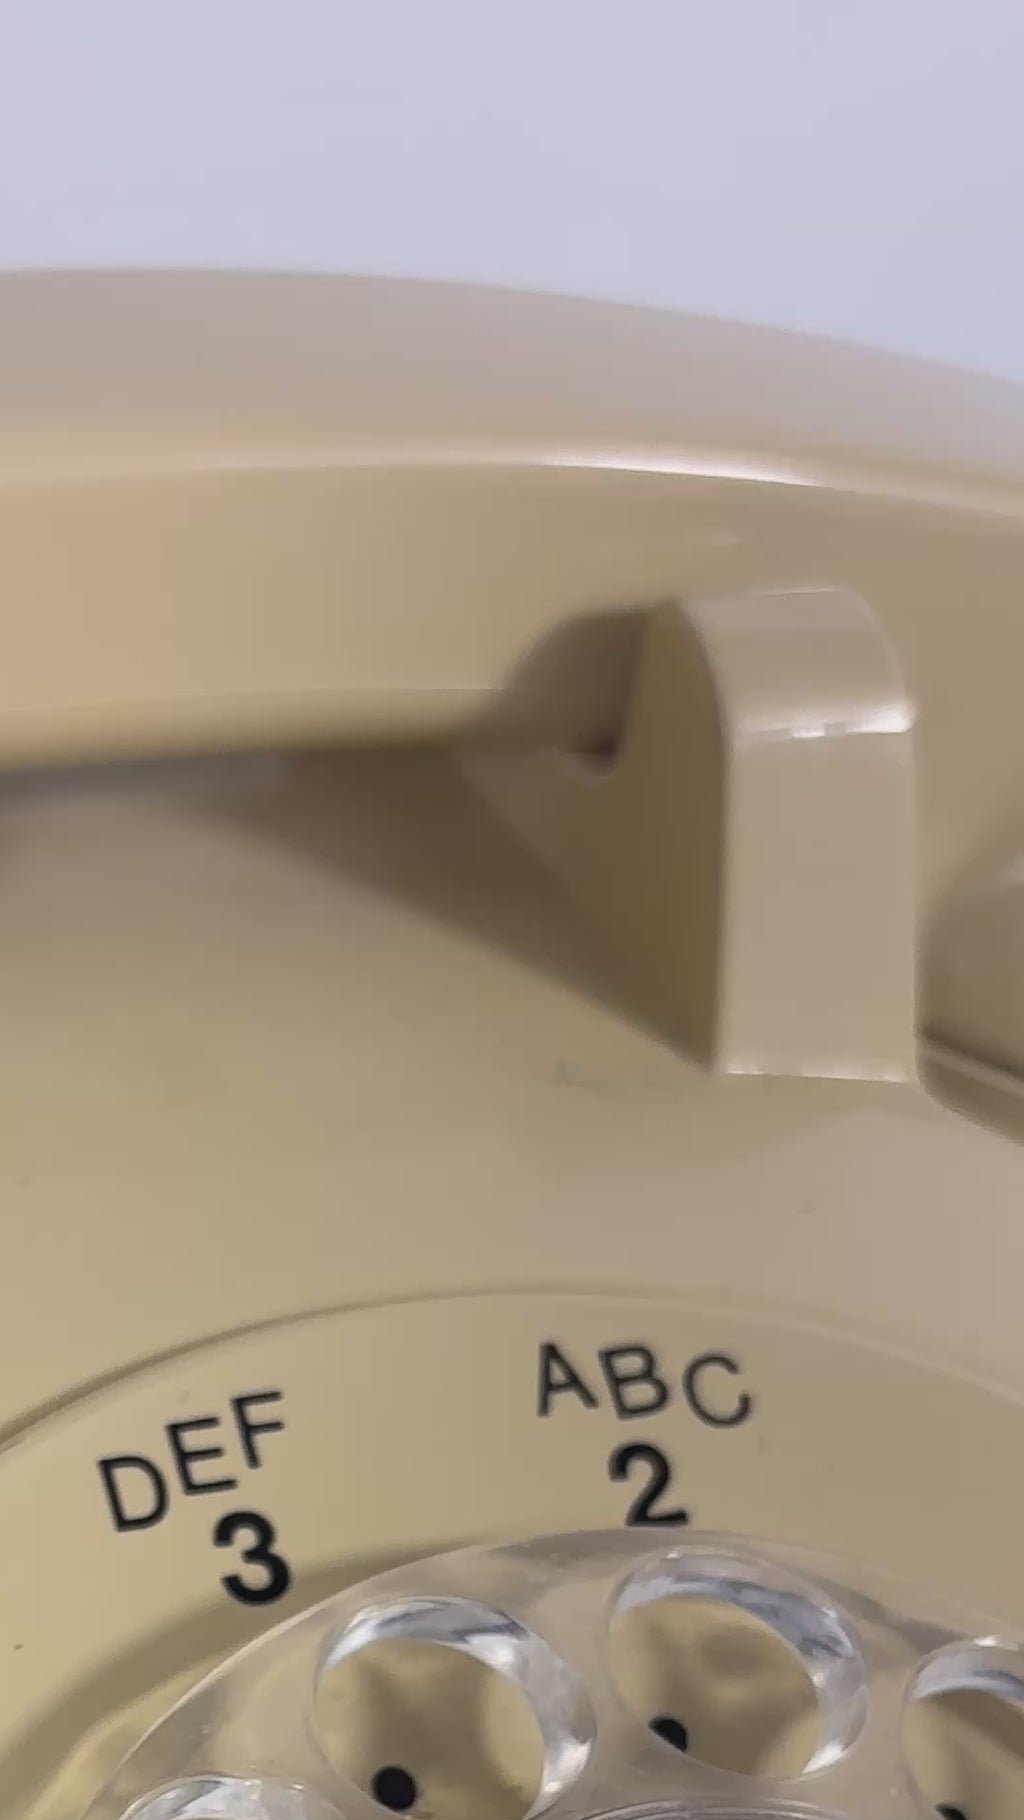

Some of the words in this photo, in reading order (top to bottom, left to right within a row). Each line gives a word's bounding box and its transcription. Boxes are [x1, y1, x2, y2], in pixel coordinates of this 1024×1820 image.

[537, 1340, 753, 1428] ABC
[96, 1389, 286, 1533] DEF
[608, 1440, 691, 1529] 2
[212, 1508, 294, 1608] 3
